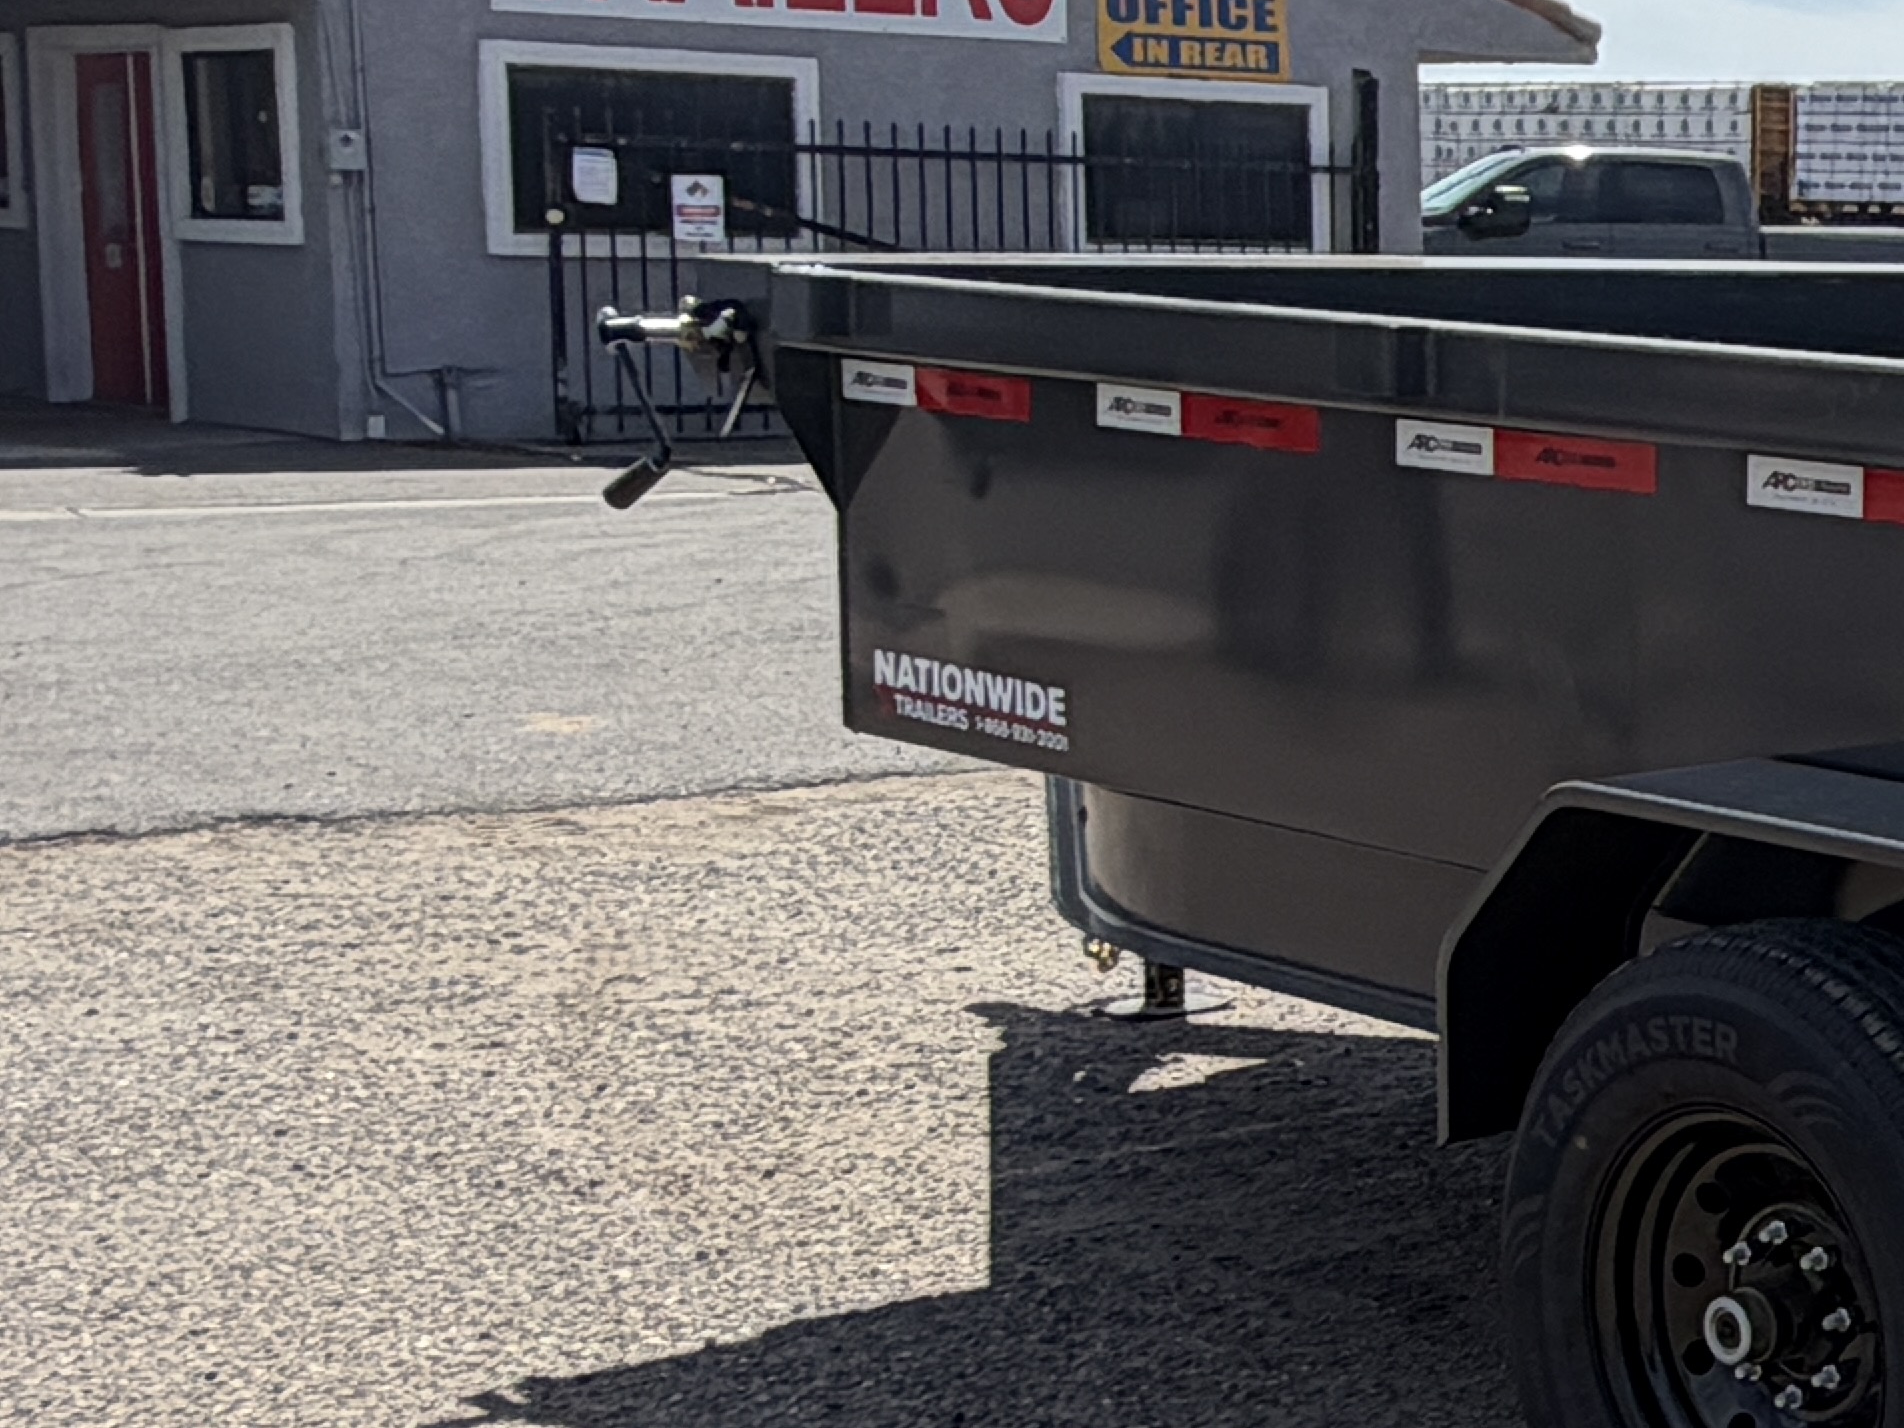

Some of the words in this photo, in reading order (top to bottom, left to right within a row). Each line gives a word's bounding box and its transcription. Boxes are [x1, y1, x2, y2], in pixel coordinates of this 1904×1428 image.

[1131, 36, 1170, 63] IN
[1180, 39, 1269, 69] REAR
[874, 649, 1067, 727] NATIONWIDE
[893, 693, 970, 732] TRAILERS
[1530, 1014, 1742, 1149] TASKMASTER
